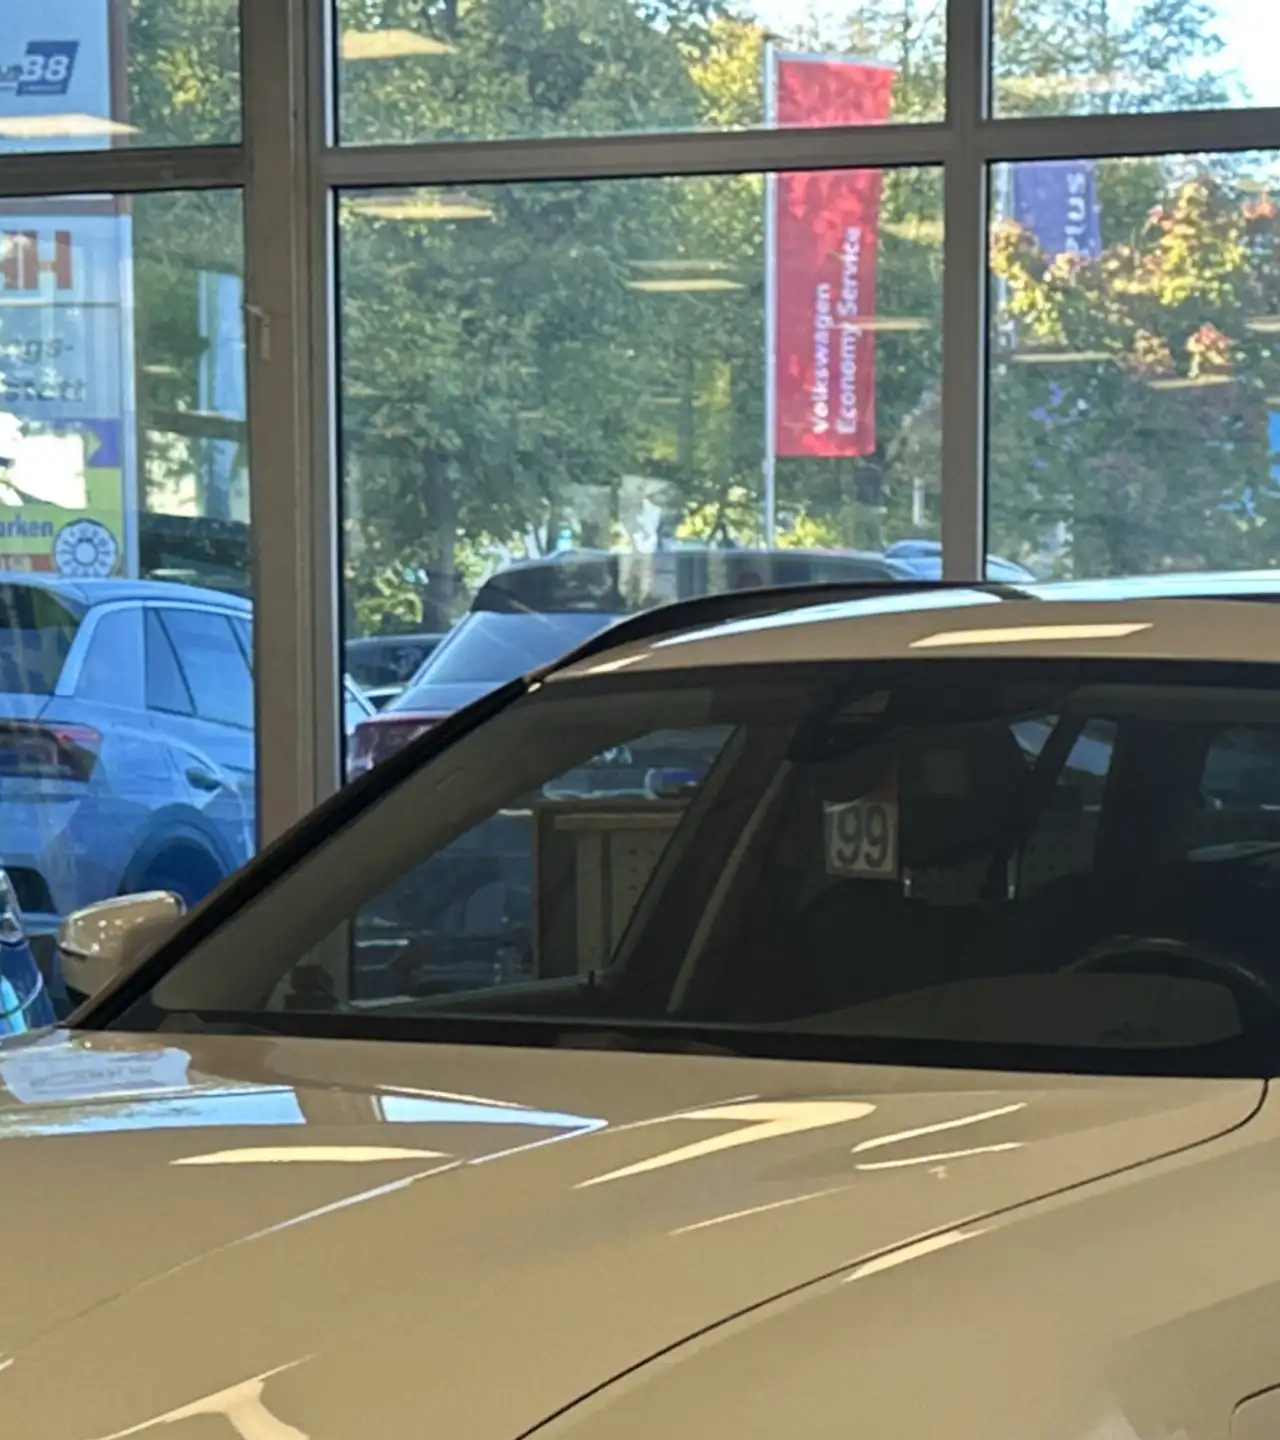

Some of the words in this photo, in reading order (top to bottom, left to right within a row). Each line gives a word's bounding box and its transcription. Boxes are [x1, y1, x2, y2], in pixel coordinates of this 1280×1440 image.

[835, 226, 862, 317] Service
[811, 282, 835, 435] Volkswagen
[835, 321, 862, 435] Economy
[836, 802, 890, 869] 99
